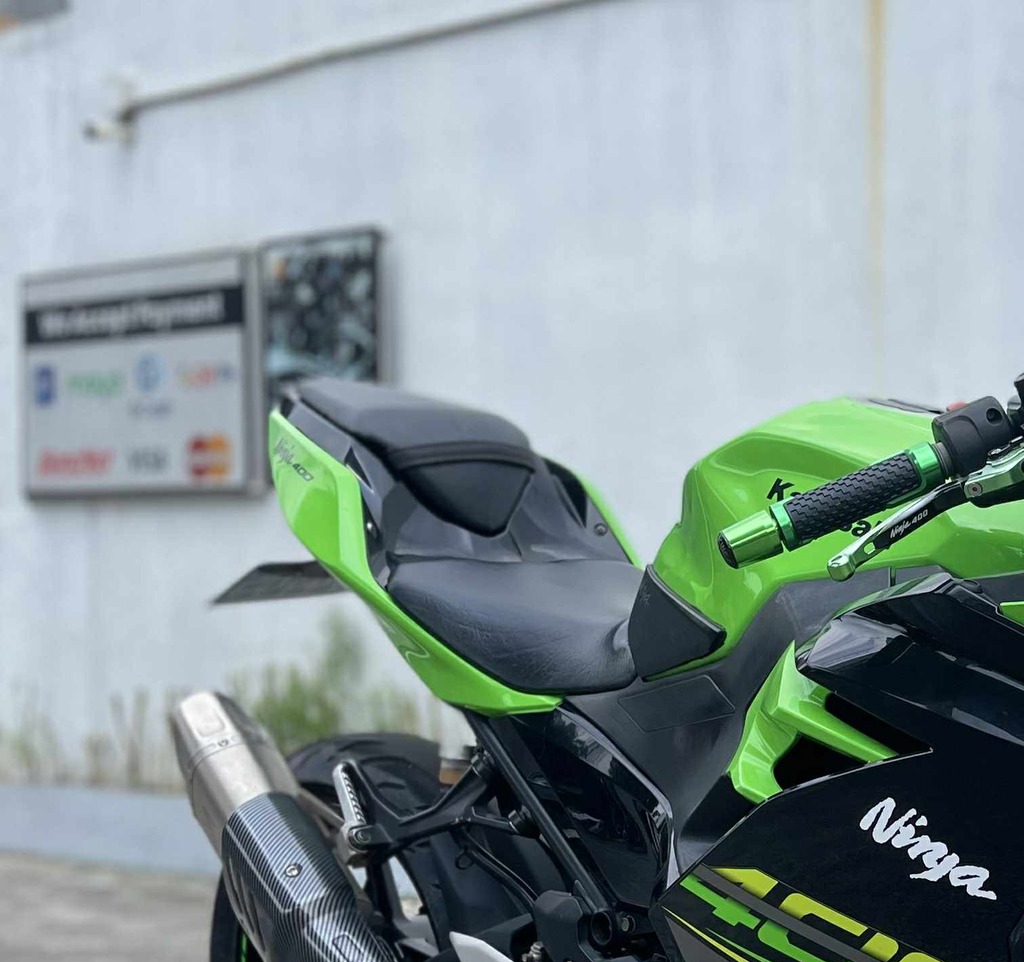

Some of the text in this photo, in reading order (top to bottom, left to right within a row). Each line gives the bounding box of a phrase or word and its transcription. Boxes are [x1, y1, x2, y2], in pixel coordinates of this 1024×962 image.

[292, 463, 314, 481] 400
[889, 508, 929, 539] Ninja 400
[858, 796, 997, 900] Ninja
